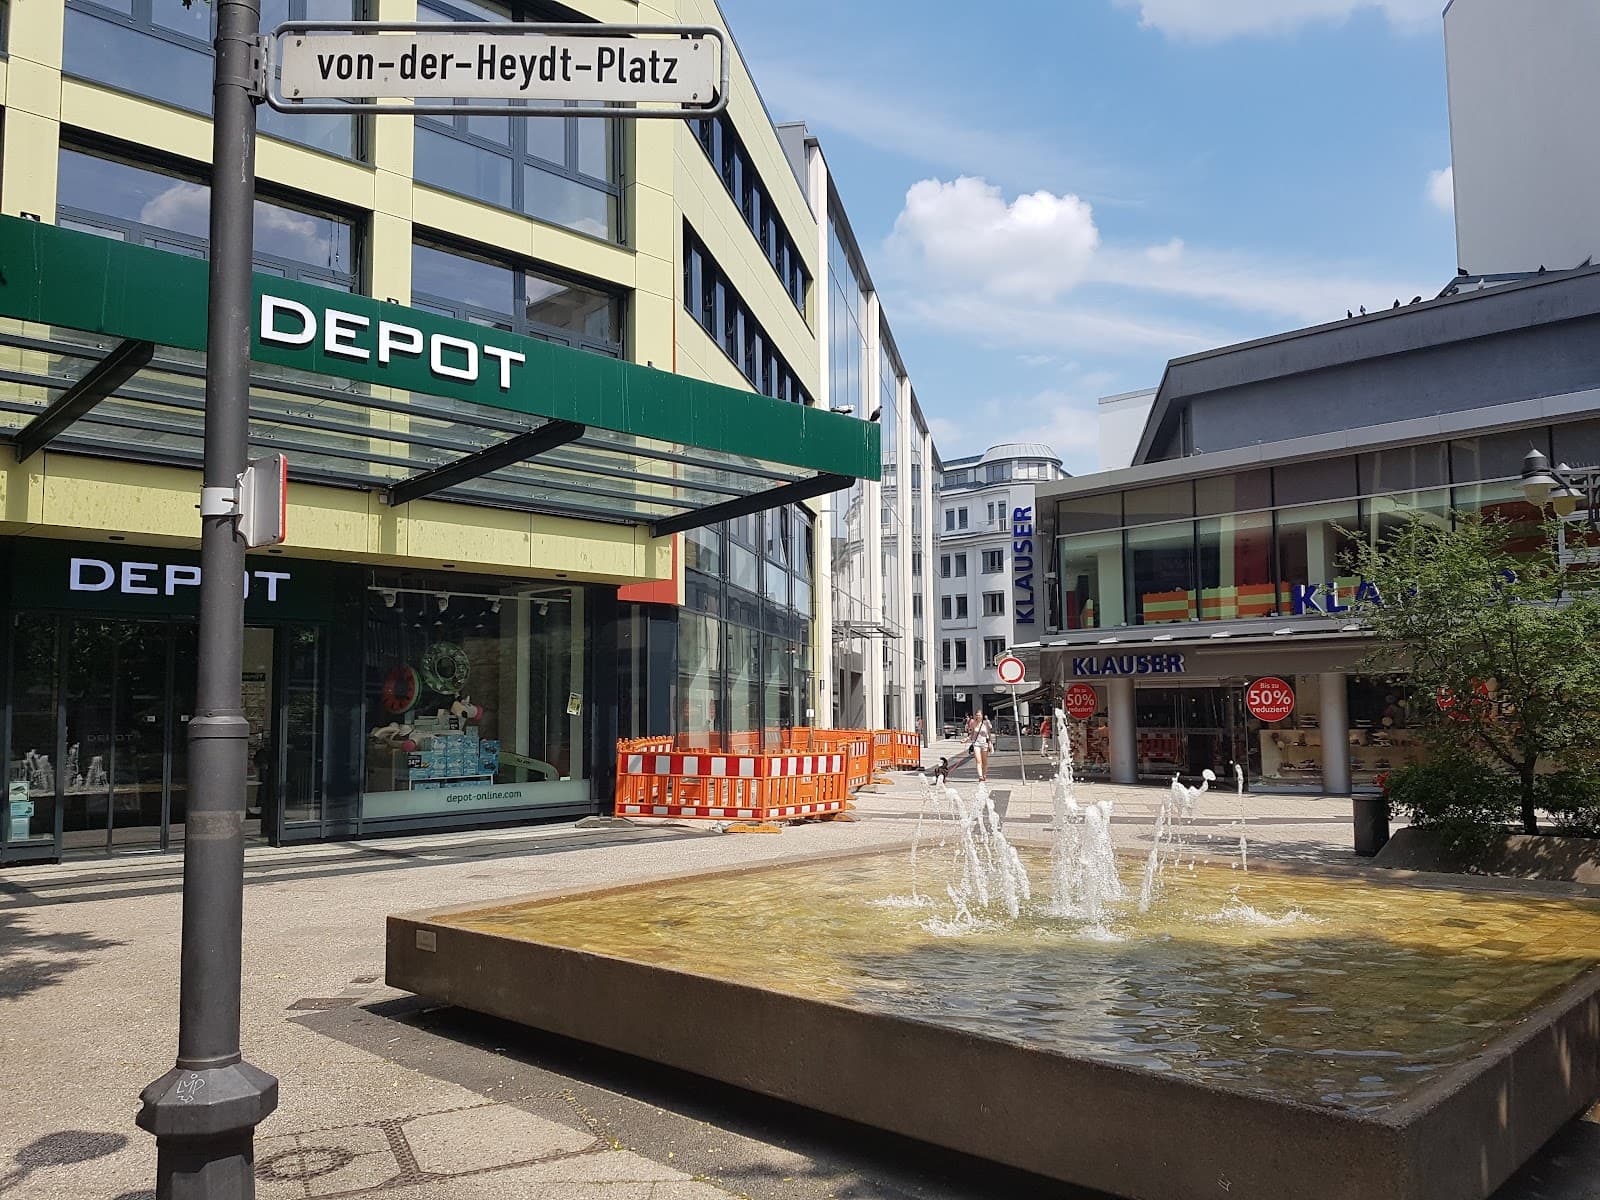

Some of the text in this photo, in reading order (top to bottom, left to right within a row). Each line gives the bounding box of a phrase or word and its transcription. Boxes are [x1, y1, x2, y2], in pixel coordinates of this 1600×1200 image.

[317, 44, 679, 90] von-der-Heydt-Platz
[260, 294, 526, 390] DEPOT
[1013, 506, 1035, 624] KLAUSER
[69, 557, 291, 602] DEPT
[1073, 654, 1185, 675] KLAUSER
[1066, 693, 1095, 706] 50%
[1250, 690, 1292, 705] 50%
[1252, 705, 1289, 713] reduziert!
[446, 789, 523, 805] depot-online.com
